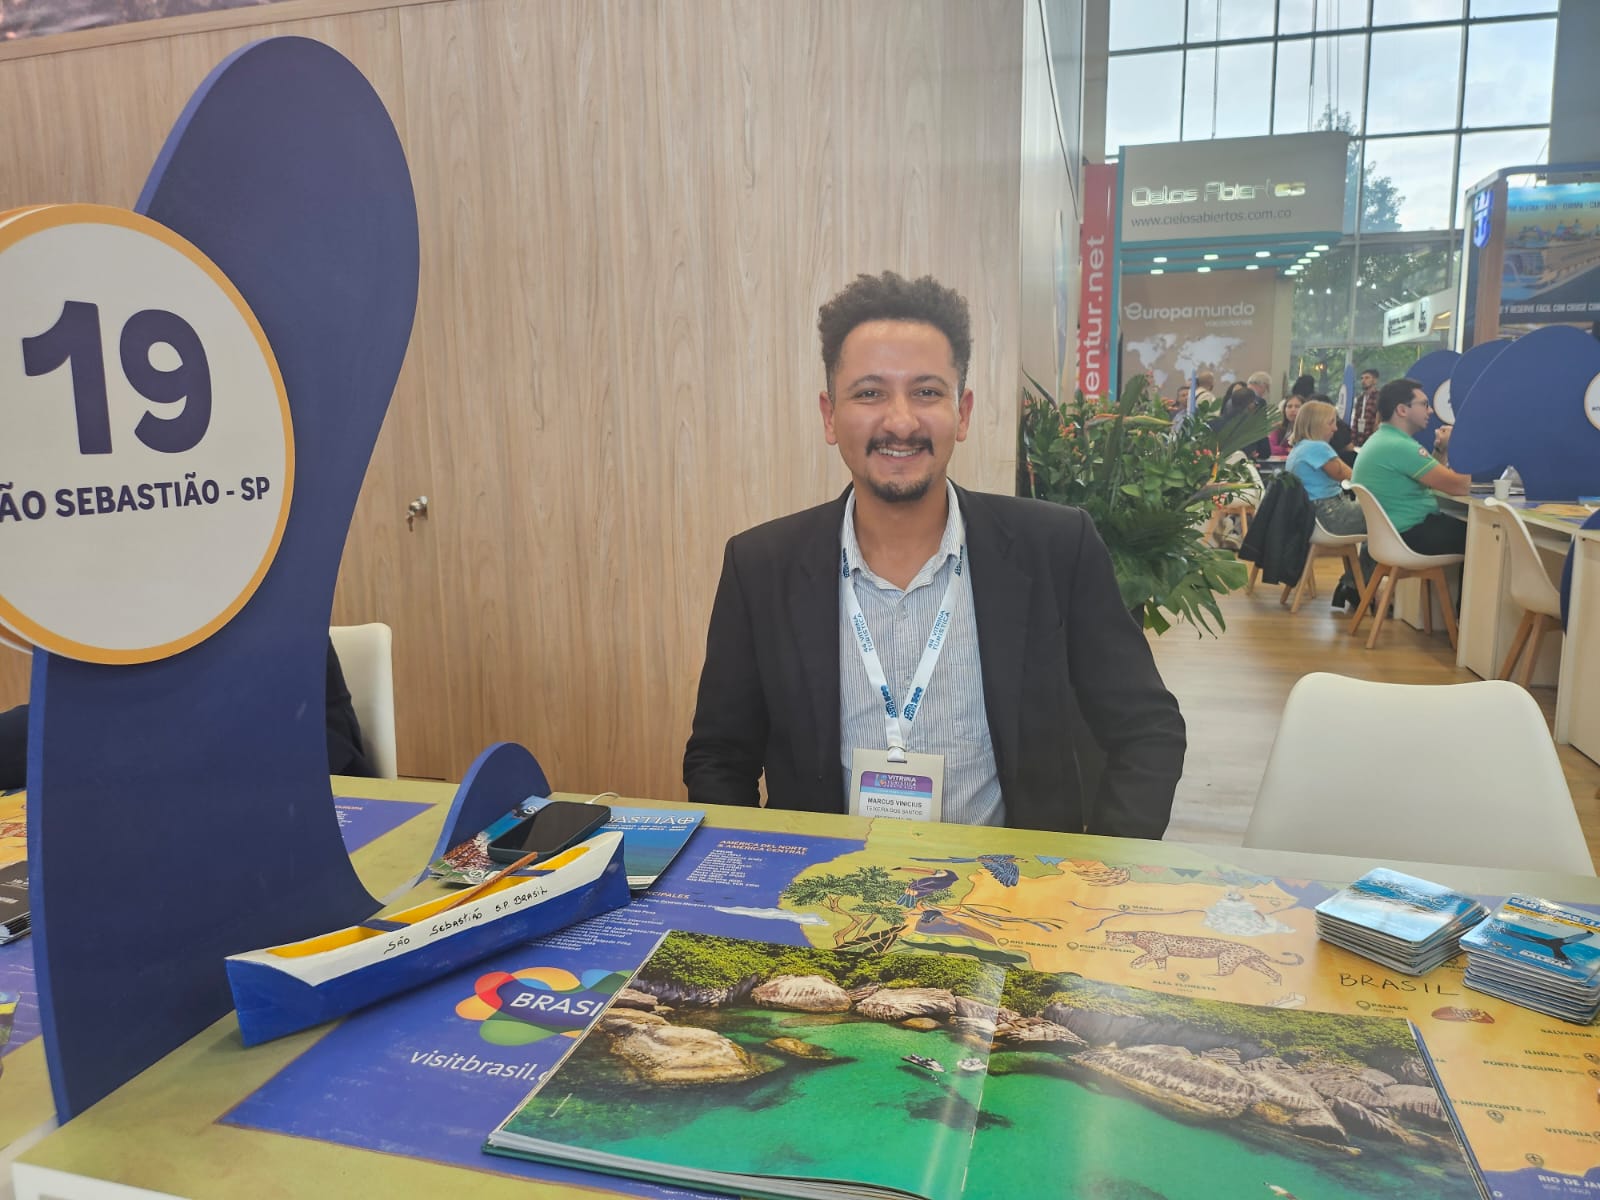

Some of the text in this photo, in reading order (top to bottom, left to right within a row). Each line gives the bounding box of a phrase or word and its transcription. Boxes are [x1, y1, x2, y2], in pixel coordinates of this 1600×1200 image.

[1131, 208, 1292, 228] www.cielosabiertos.com.co
[21, 300, 213, 455] 19
[55, 471, 220, 518] SEBASTIÃO
[240, 476, 270, 501] SP
[887, 774, 917, 782] VITRINA
[867, 797, 923, 808] MARCUS VINICIUS
[610, 815, 695, 825] ASTIÃO
[1339, 972, 1461, 997] BRASIL
[1537, 1174, 1560, 1184] RIO
[1562, 1177, 1580, 1187] DE
